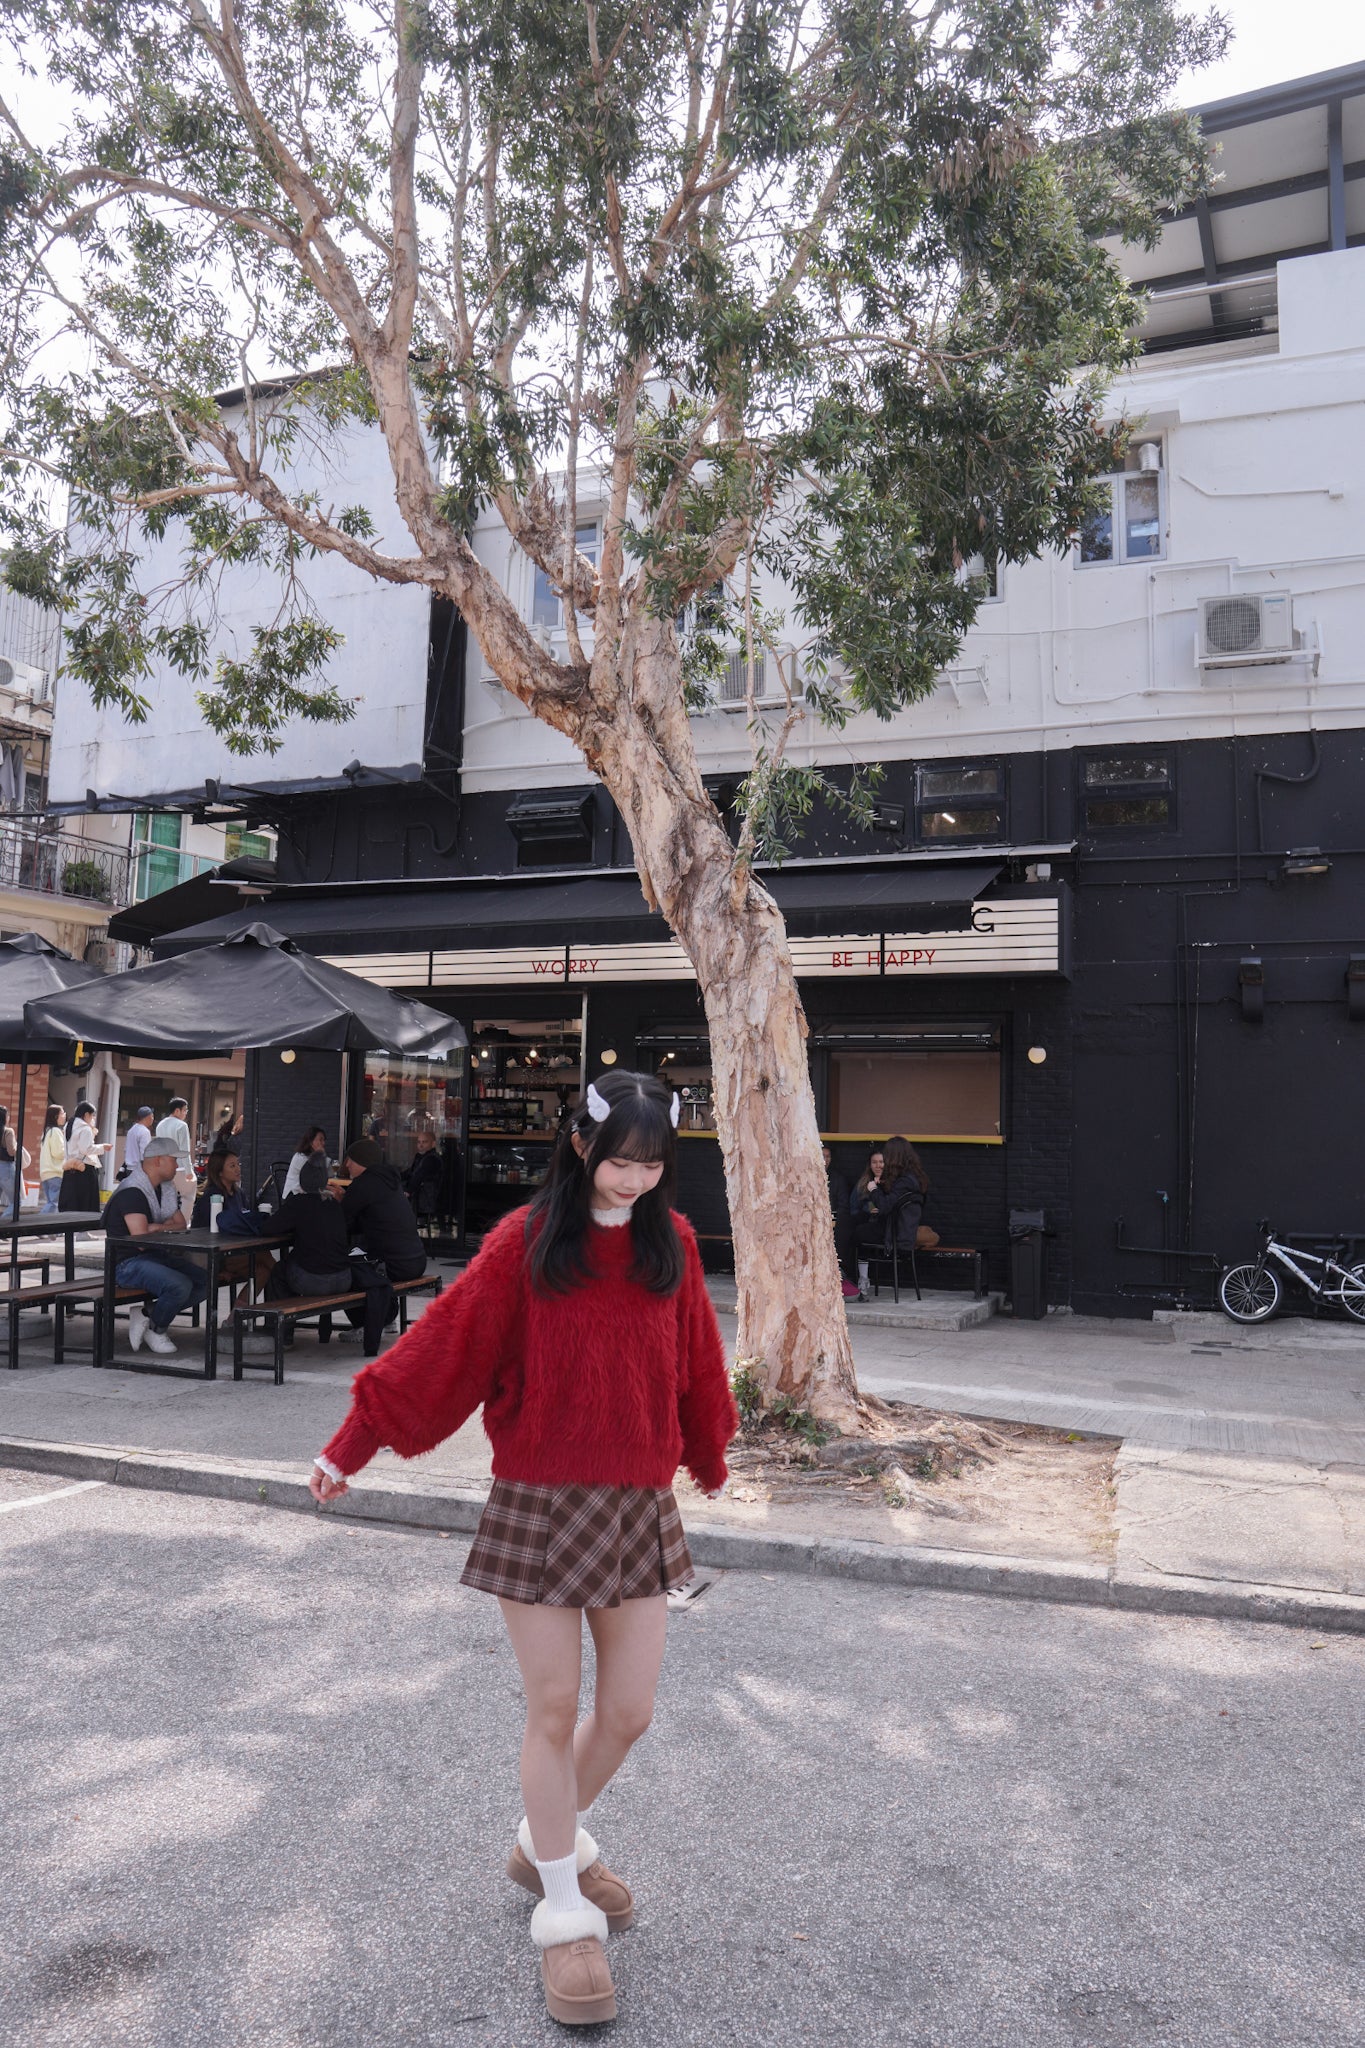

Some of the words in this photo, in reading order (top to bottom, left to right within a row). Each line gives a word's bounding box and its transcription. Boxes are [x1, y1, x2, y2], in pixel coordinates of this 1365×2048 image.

[832, 952, 853, 967] BE
[868, 949, 936, 967] HAPPY
[531, 960, 599, 975] WORRY
